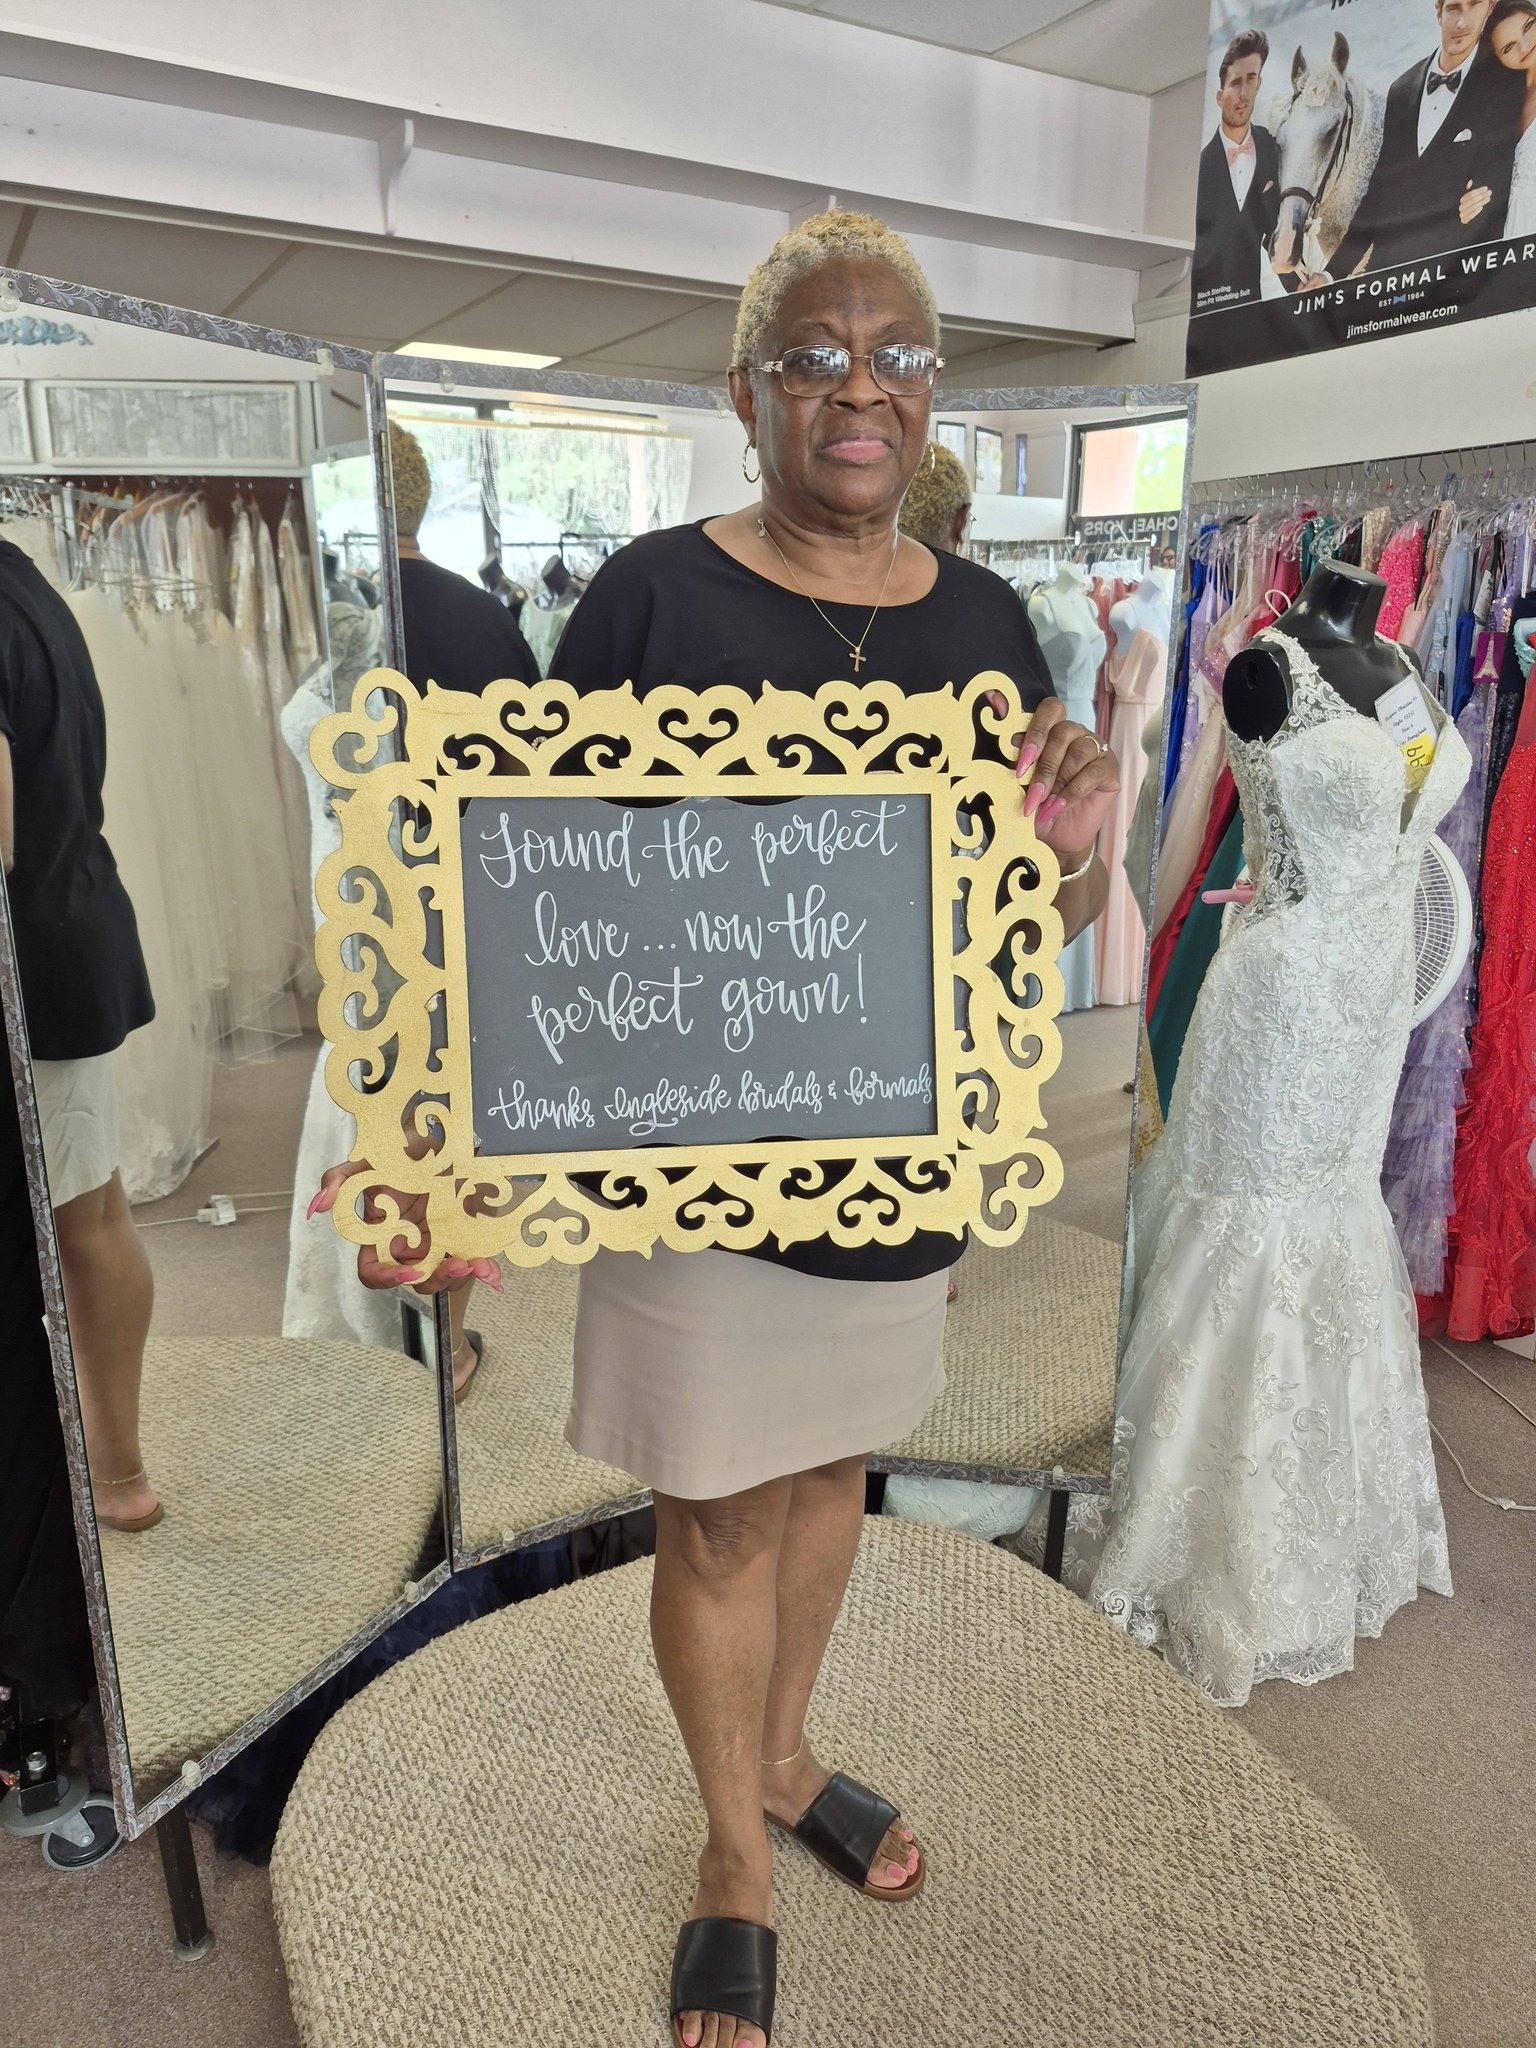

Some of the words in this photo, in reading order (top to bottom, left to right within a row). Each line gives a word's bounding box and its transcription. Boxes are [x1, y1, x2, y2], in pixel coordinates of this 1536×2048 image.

[1293, 290, 1345, 315] JIM'S
[1356, 265, 1447, 300] FORMAL
[1461, 243, 1535, 274] WEAR
[1379, 298, 1392, 308] EST
[1407, 291, 1425, 301] 1964
[1346, 304, 1458, 339] jimsformalwear.com
[480, 811, 640, 888] Found
[642, 810, 730, 880] the
[752, 801, 906, 887] perfect
[525, 891, 629, 967] love
[685, 911, 762, 960] now
[767, 884, 866, 960] the
[527, 966, 703, 1064] perfect
[721, 953, 867, 1052] gown!
[488, 1079, 595, 1130] thanks
[604, 1074, 731, 1136] Ingleside
[738, 1069, 823, 1114] bridals
[827, 1080, 837, 1100] &
[844, 1062, 932, 1104] formals
